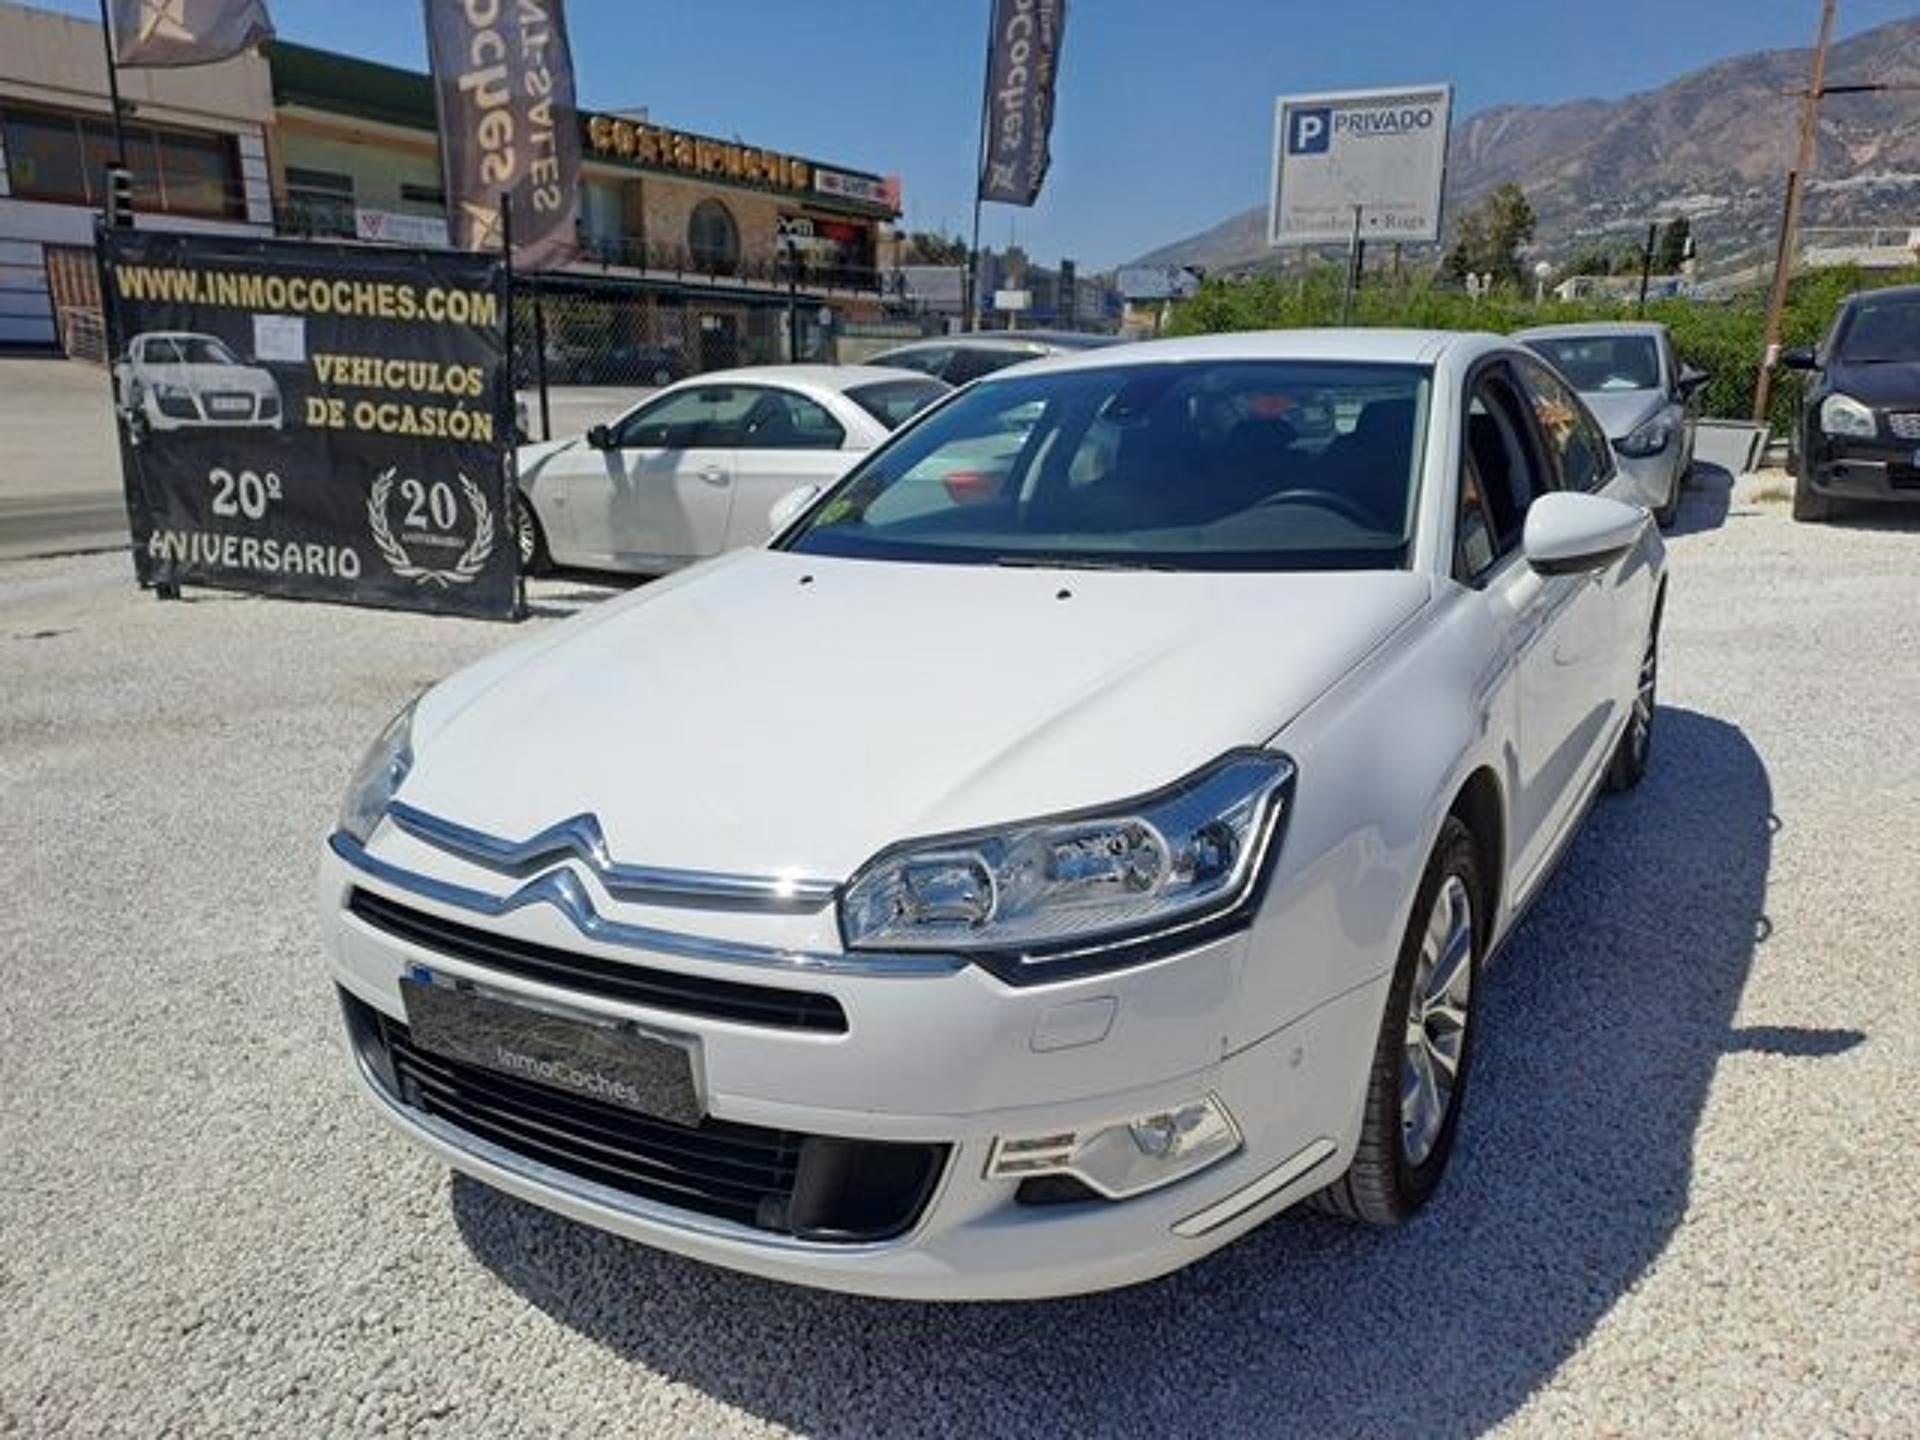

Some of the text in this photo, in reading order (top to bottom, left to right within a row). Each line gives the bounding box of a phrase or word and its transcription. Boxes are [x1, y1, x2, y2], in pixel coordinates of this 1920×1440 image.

[1298, 108, 1433, 149] P PRIVADO
[115, 264, 497, 327] WWW.INMOCOCHES.COM
[312, 353, 484, 396] VEHICULOS
[306, 397, 493, 442] DE OCASIÓN
[400, 479, 457, 530] 20
[149, 530, 361, 580] ANIVERSARIO
